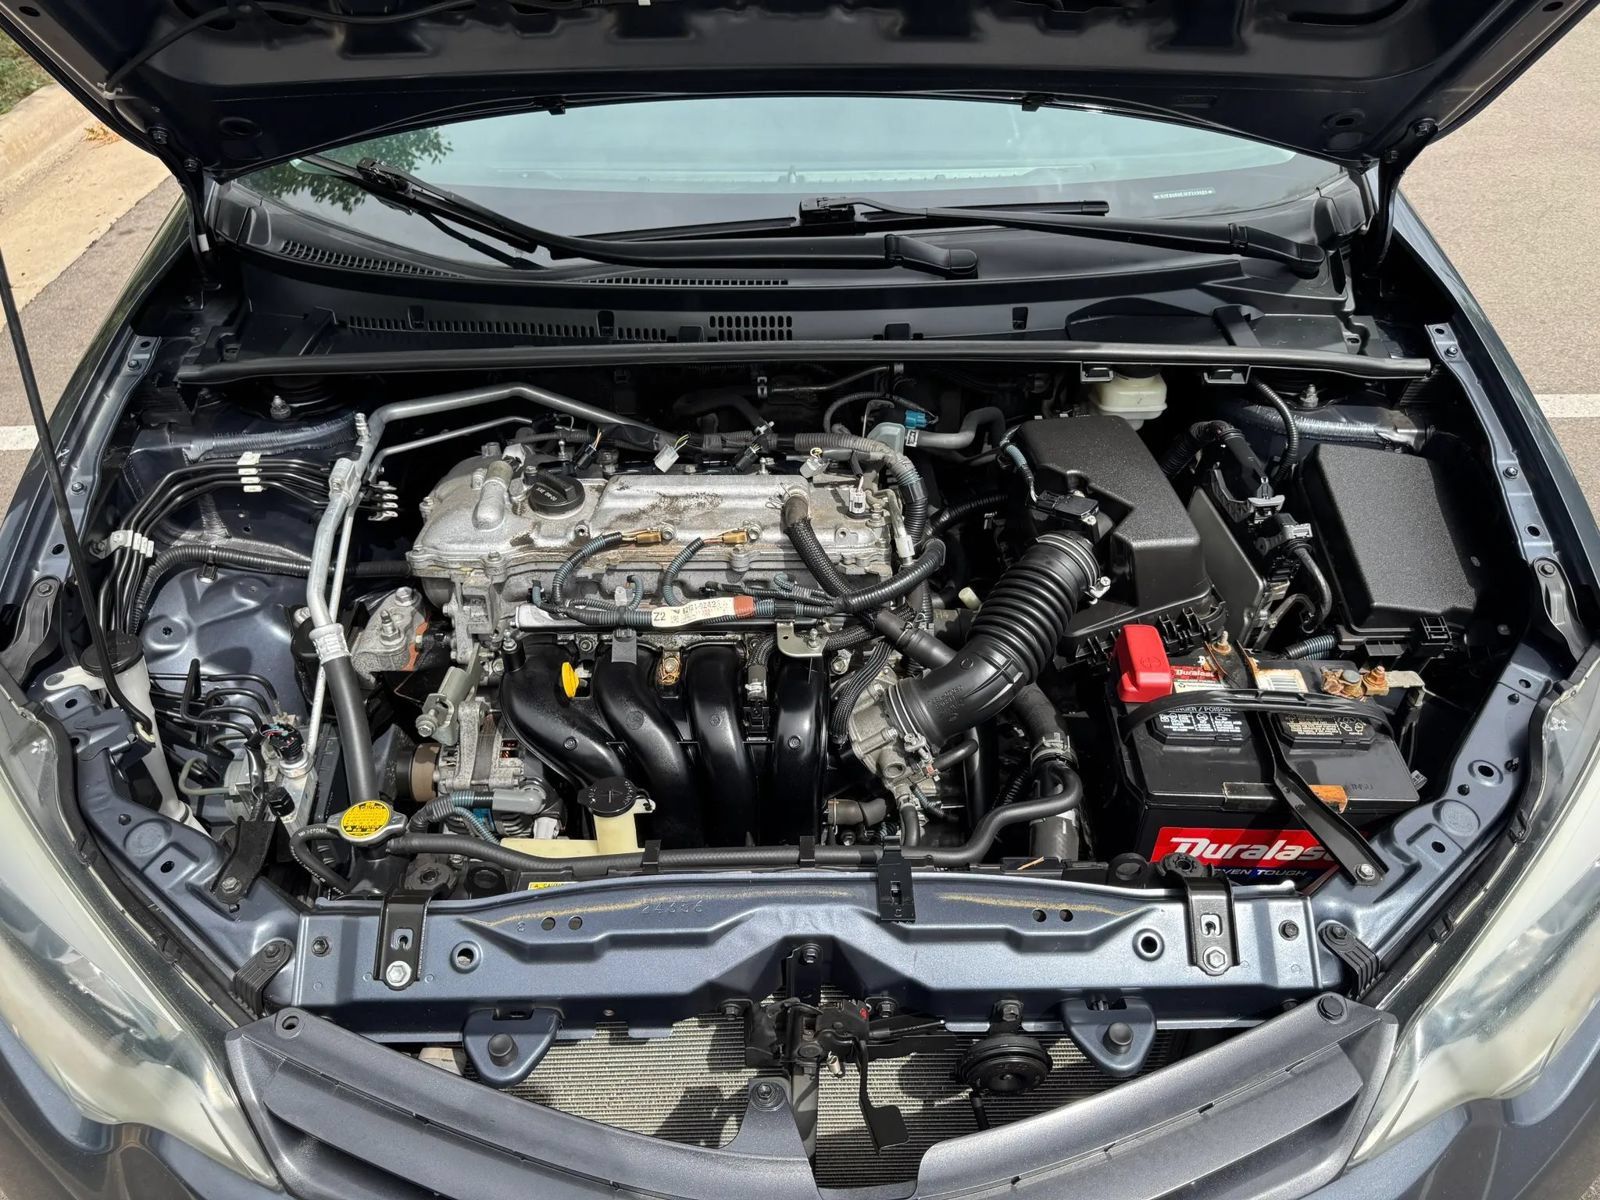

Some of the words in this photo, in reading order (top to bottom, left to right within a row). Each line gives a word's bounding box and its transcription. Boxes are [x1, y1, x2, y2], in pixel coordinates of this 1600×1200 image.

[652, 611, 666, 621] Z2
[1170, 837, 1335, 861] Duralas
[1256, 868, 1308, 877] TOUGH
